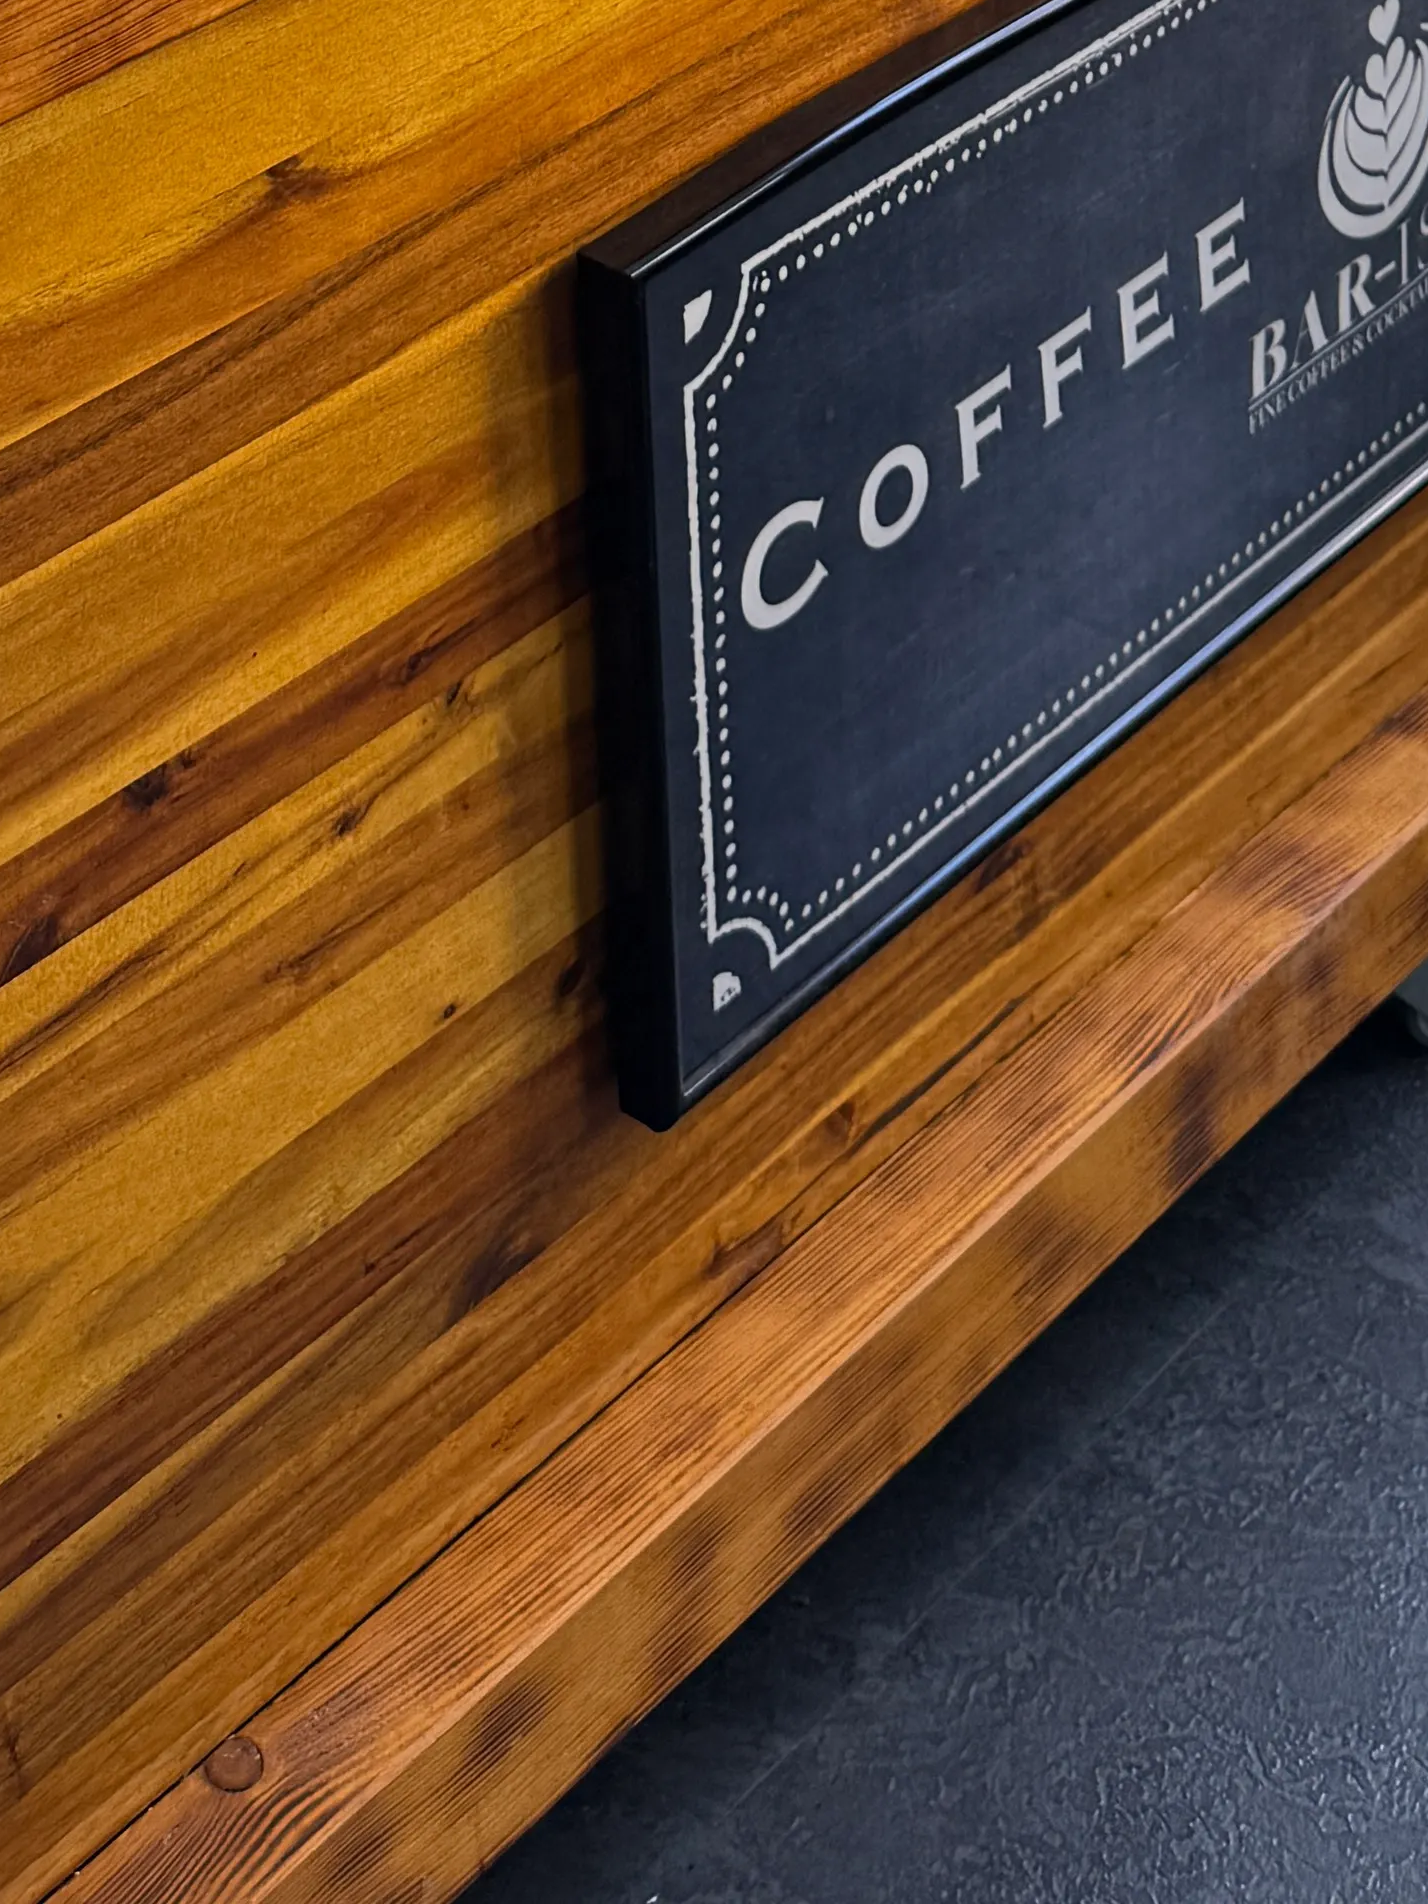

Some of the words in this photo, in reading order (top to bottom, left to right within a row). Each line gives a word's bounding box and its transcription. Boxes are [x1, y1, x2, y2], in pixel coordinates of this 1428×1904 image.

[740, 196, 1251, 630] COFFEE
[1248, 390, 1286, 435] FINE
[1286, 344, 1351, 404] COFFEE
[1351, 336, 1365, 358] &
